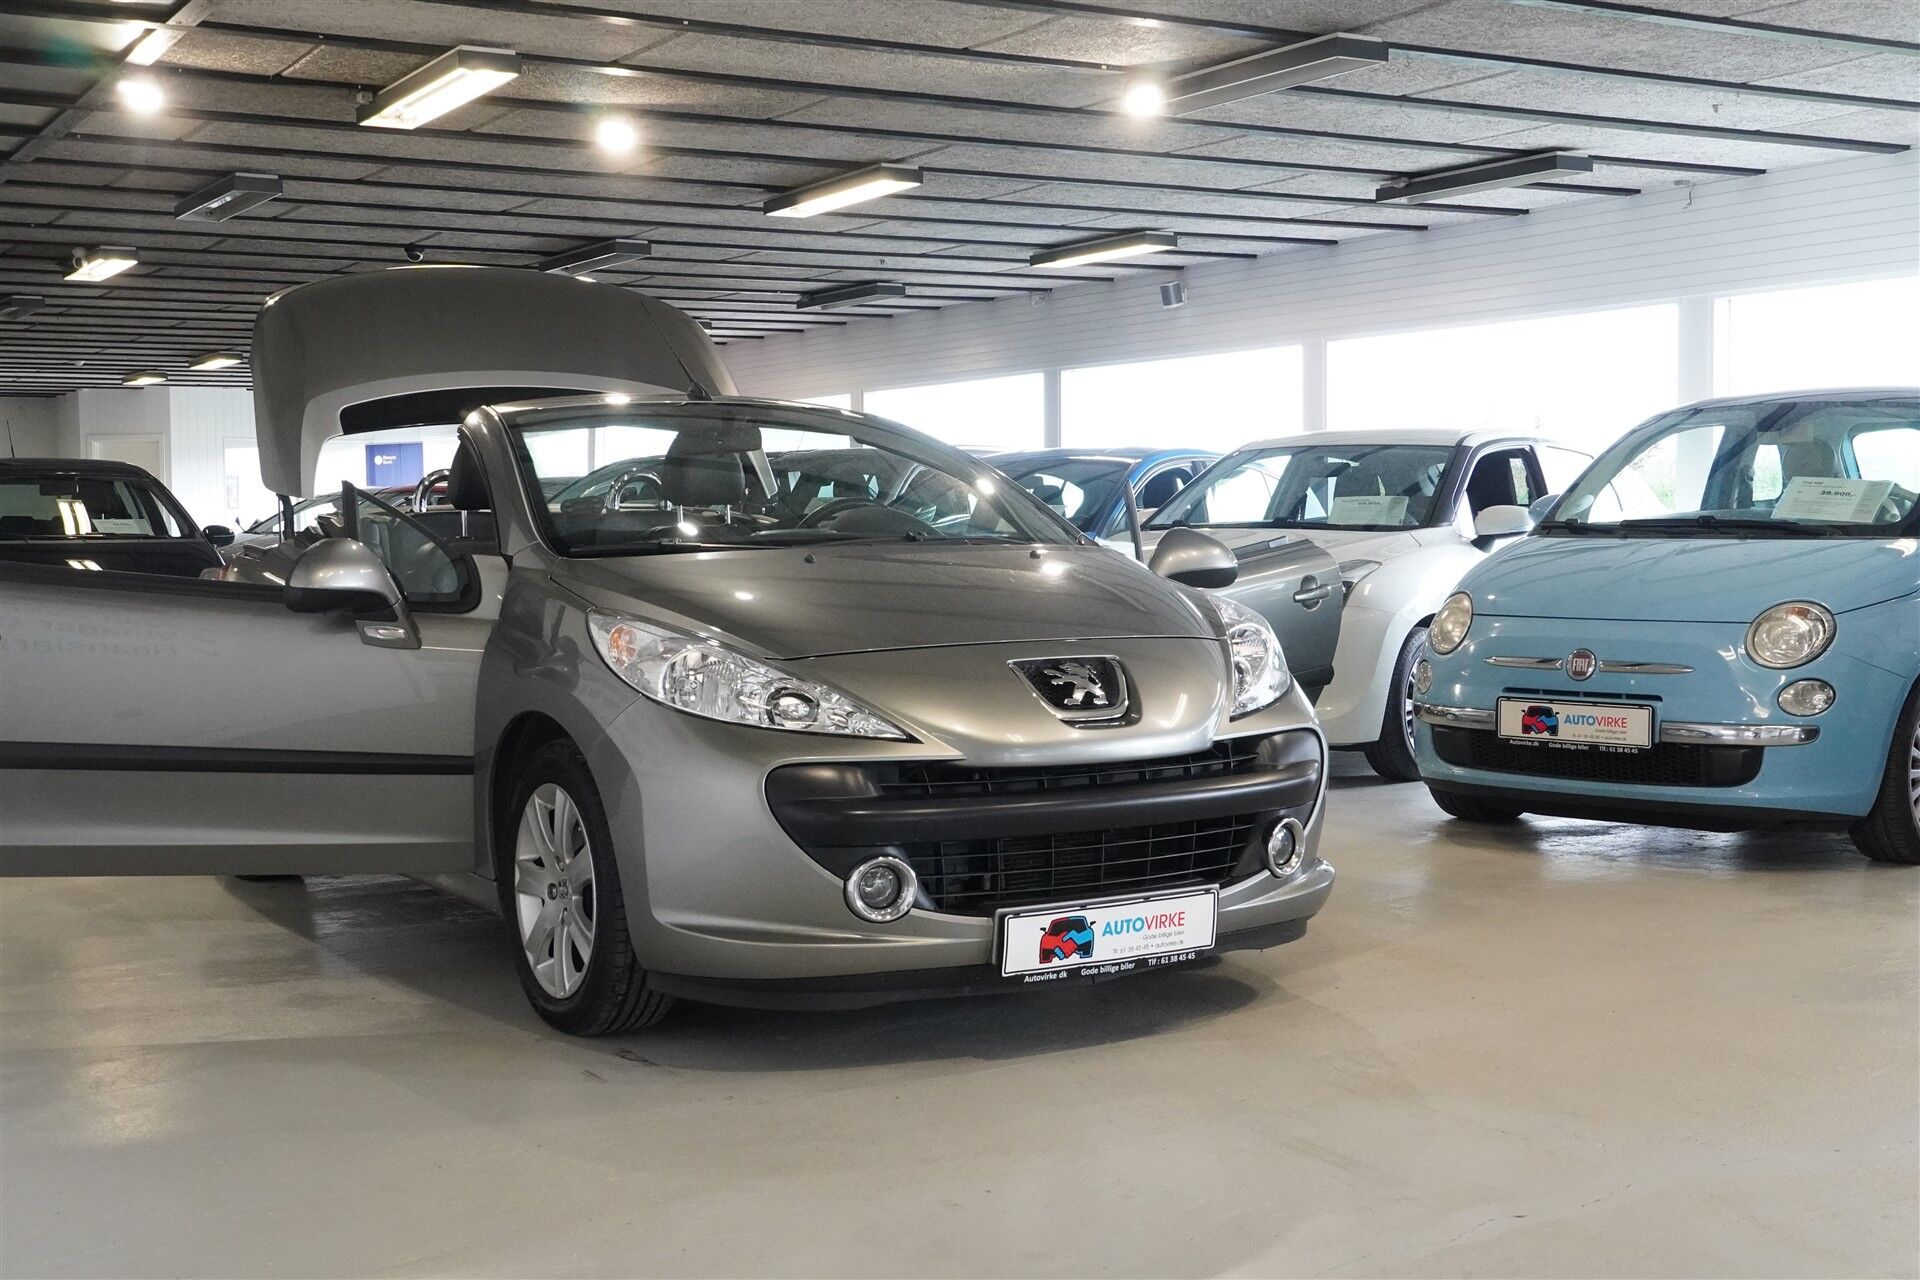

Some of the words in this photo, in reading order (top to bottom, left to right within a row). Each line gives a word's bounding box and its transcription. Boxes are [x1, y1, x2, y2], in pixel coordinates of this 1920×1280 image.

[1572, 657, 1590, 672] FIAT
[1564, 713, 1627, 729] AUTOVIRKE
[1102, 911, 1186, 937] AUTOVIRKE
[1161, 956, 1169, 965] 61
[1170, 955, 1178, 963] 38
[1179, 953, 1187, 962] 45
[1187, 952, 1196, 961] 45
[1081, 967, 1098, 976] Gode
[1100, 964, 1119, 974] billige
[1120, 962, 1135, 971] biler
